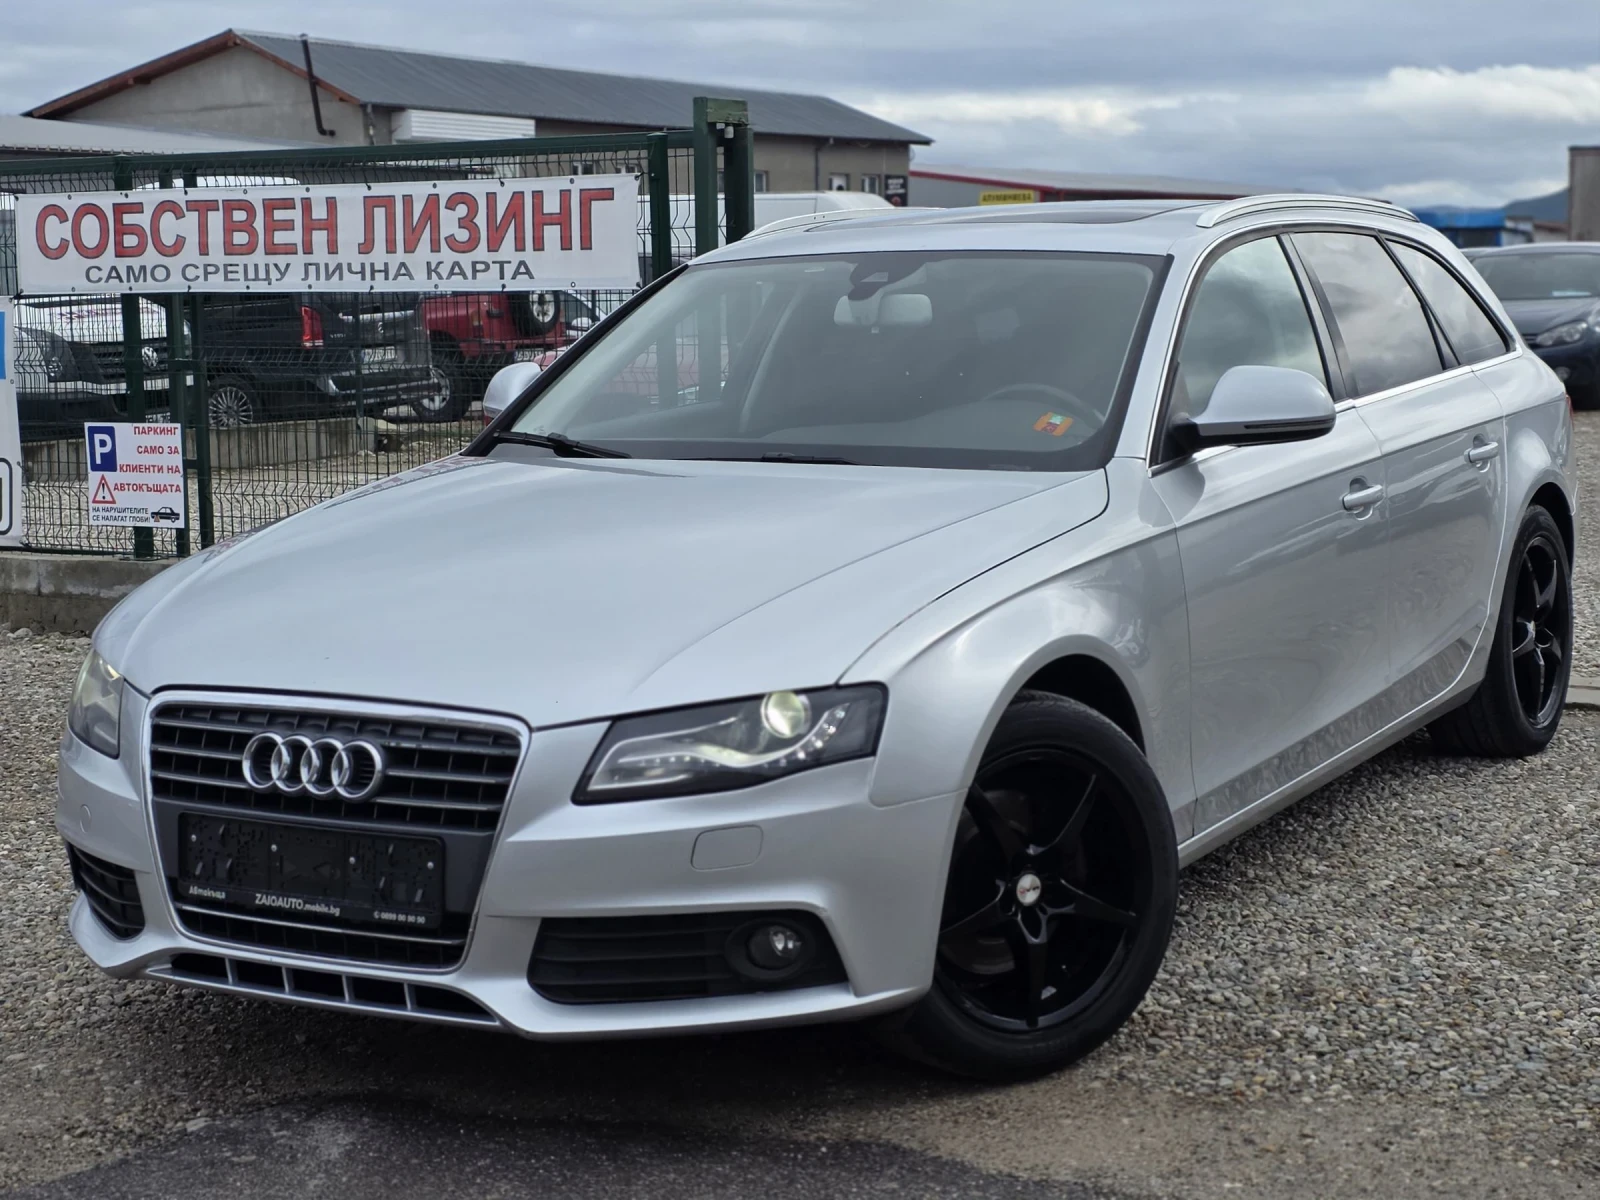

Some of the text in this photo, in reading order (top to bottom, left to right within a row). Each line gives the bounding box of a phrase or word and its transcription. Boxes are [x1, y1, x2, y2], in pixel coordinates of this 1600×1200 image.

[36, 187, 614, 260] СОБСТВЕН ЛИЗИНГ
[85, 260, 535, 286] САМО СРЕЩУ ЛИЧНА КАРТА
[133, 426, 178, 436] ПАРКИНГ
[94, 433, 112, 465] P
[137, 445, 180, 455] САМО ЗА
[119, 464, 180, 474] КЛИЕНТИ НА
[113, 483, 181, 495] АВТОКЪЩАТА
[101, 507, 148, 515] НАРУШИТЕЛИТЕ
[129, 515, 150, 523] ГЛОБИ!
